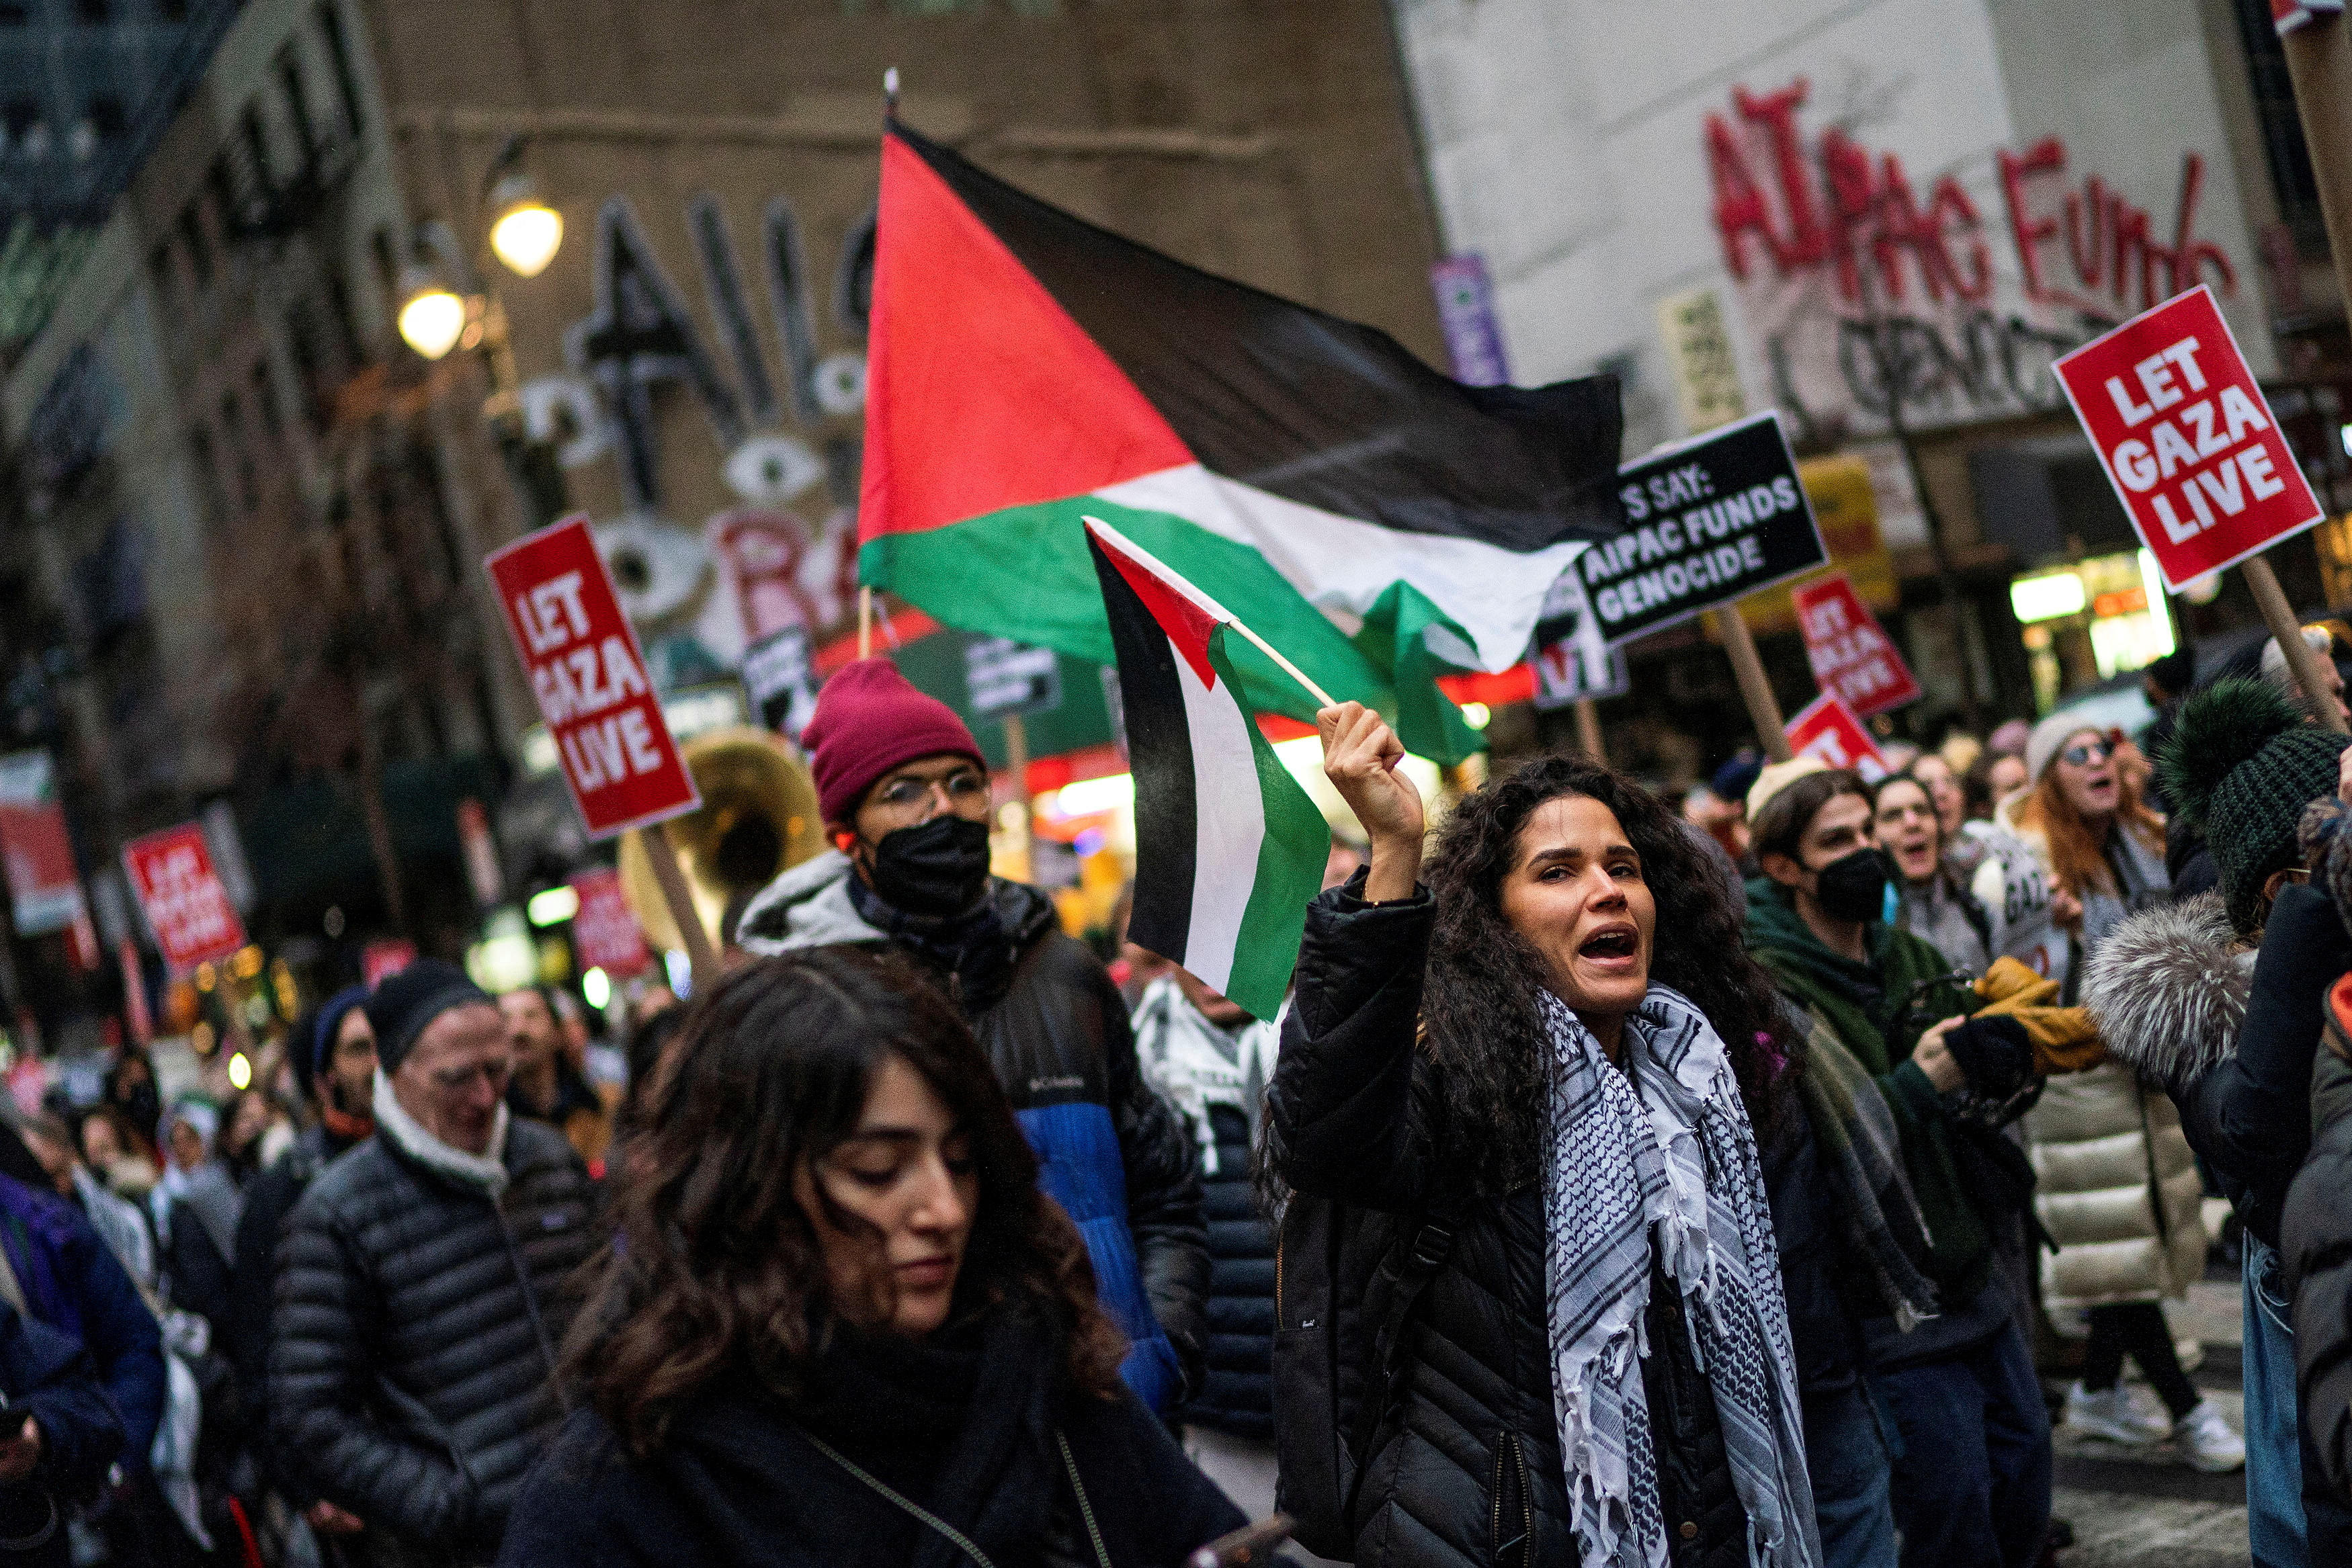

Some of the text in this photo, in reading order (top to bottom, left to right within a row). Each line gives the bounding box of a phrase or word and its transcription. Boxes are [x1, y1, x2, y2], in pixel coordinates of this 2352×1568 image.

[2105, 336, 2209, 427] LET
[2111, 386, 2271, 492] GAZA
[1583, 519, 1685, 584] AIPAC
[1685, 474, 1799, 546] FUNDS
[1652, 464, 1714, 513] SAY:
[2150, 445, 2285, 545] LIVE
[515, 570, 591, 656] LET
[1593, 538, 1765, 625] GENOCIDE
[532, 633, 648, 726] GAZA
[561, 706, 663, 793] LIVE
[2005, 871, 2058, 926] GAZ
